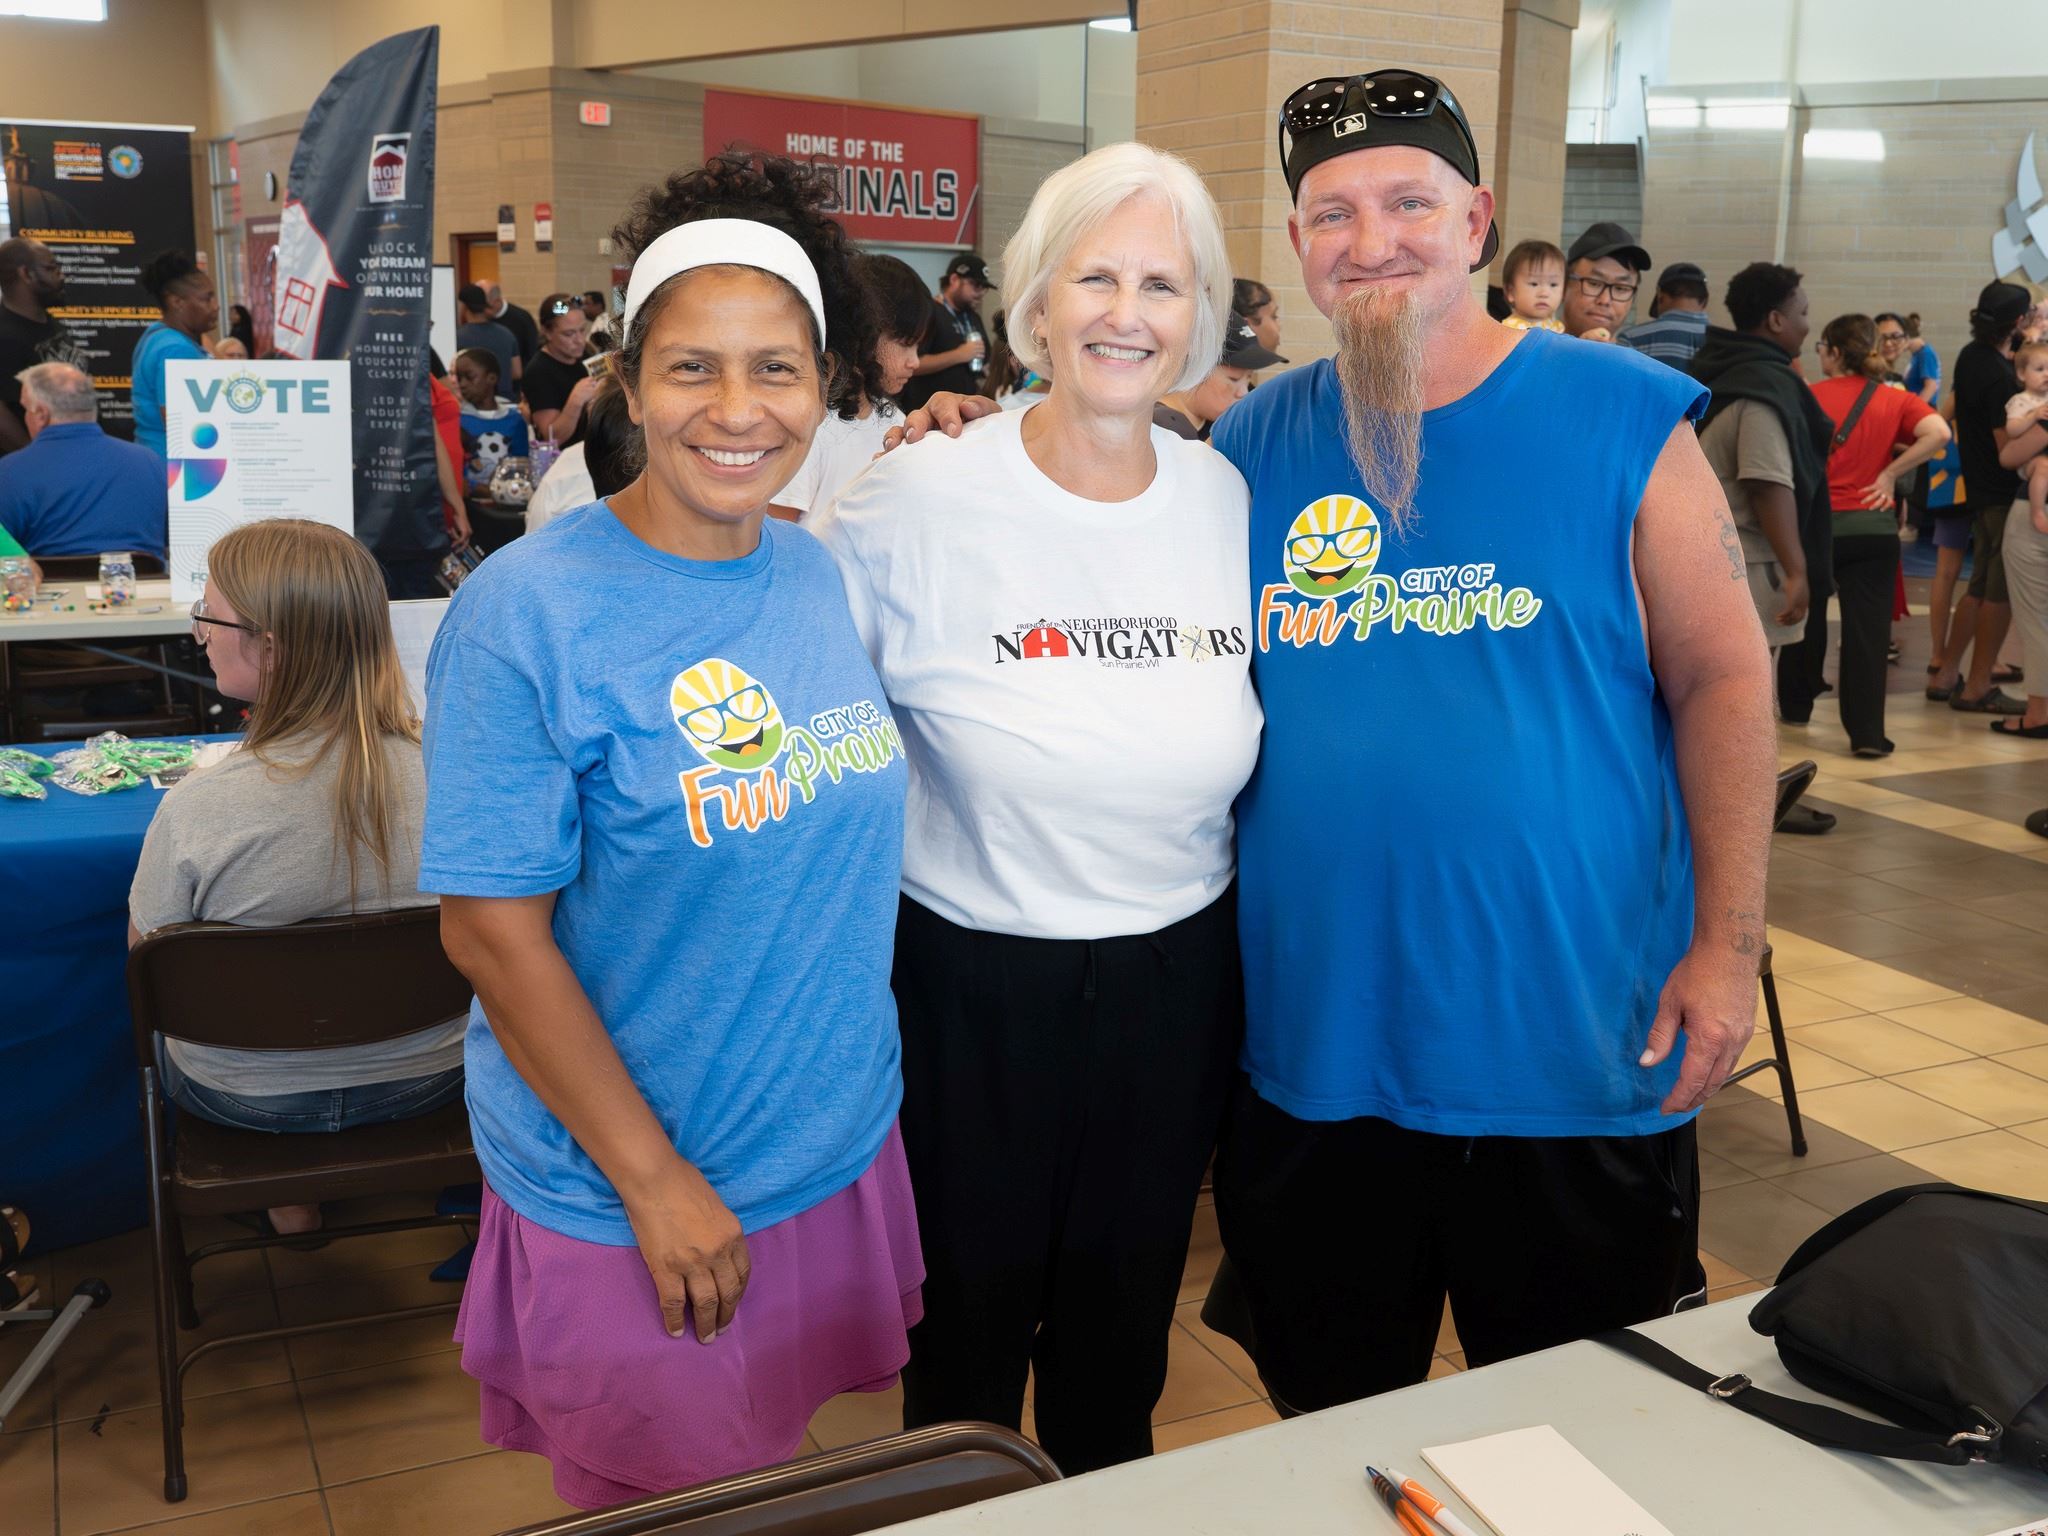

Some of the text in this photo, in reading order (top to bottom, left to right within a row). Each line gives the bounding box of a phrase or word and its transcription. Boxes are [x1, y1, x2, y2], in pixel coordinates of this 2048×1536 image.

[786, 133, 904, 163] HOME OF THE
[800, 162, 958, 221] DINALS
[382, 257, 426, 269] DREAM
[386, 286, 425, 298] HOME
[375, 332, 404, 342] FREE
[358, 358, 417, 368] EDUCATIO
[184, 378, 331, 414] VOTE
[1400, 563, 1496, 592] CITY OF
[1061, 616, 1177, 631] NEIGHBORHOOD
[1258, 574, 1542, 653] Fun Prairie
[992, 626, 1246, 664] NAVIGATORS
[1098, 658, 1115, 668] Sun
[1145, 658, 1160, 668] WI
[811, 700, 879, 738] CITY OF
[679, 764, 790, 848] Fun
